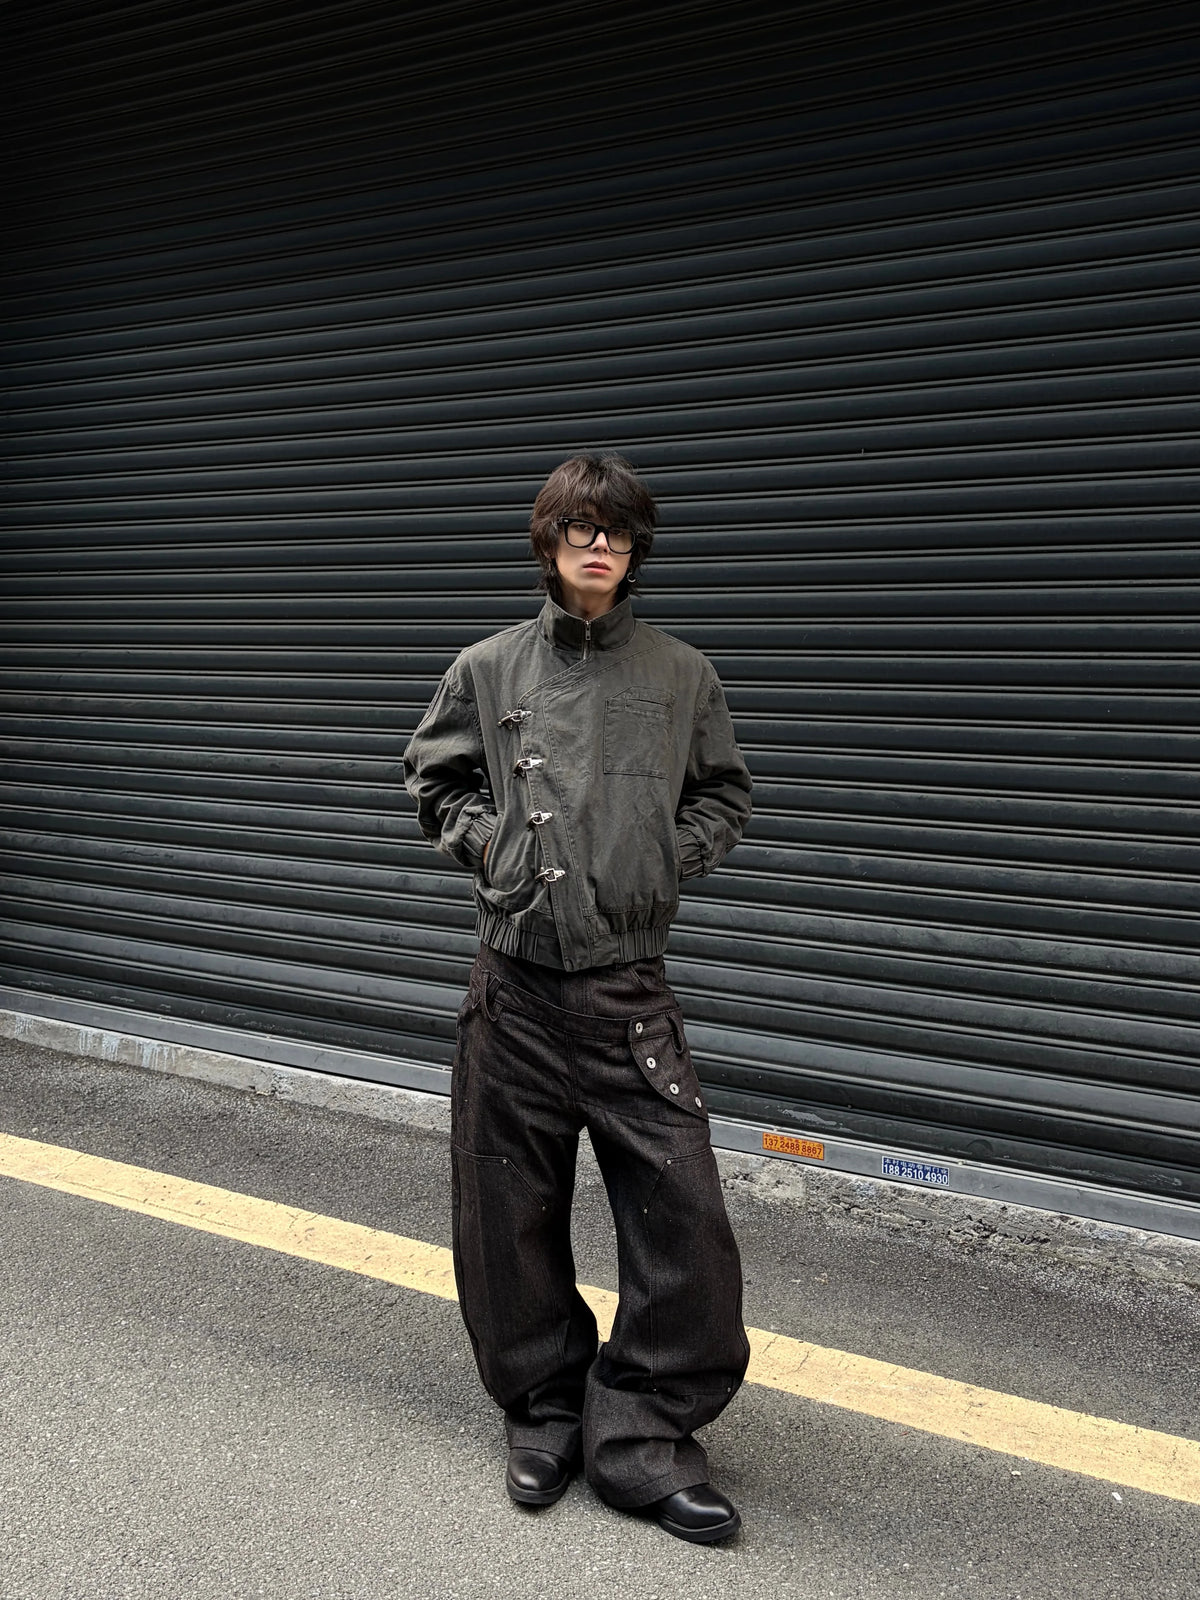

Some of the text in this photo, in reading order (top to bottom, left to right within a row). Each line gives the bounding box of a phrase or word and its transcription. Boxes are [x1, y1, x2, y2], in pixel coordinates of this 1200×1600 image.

[764, 1138, 779, 1147] 137
[780, 1140, 800, 1151] 2488
[884, 1163, 900, 1176] 188
[901, 1167, 924, 1180] 2510
[925, 1171, 948, 1184] 4930
